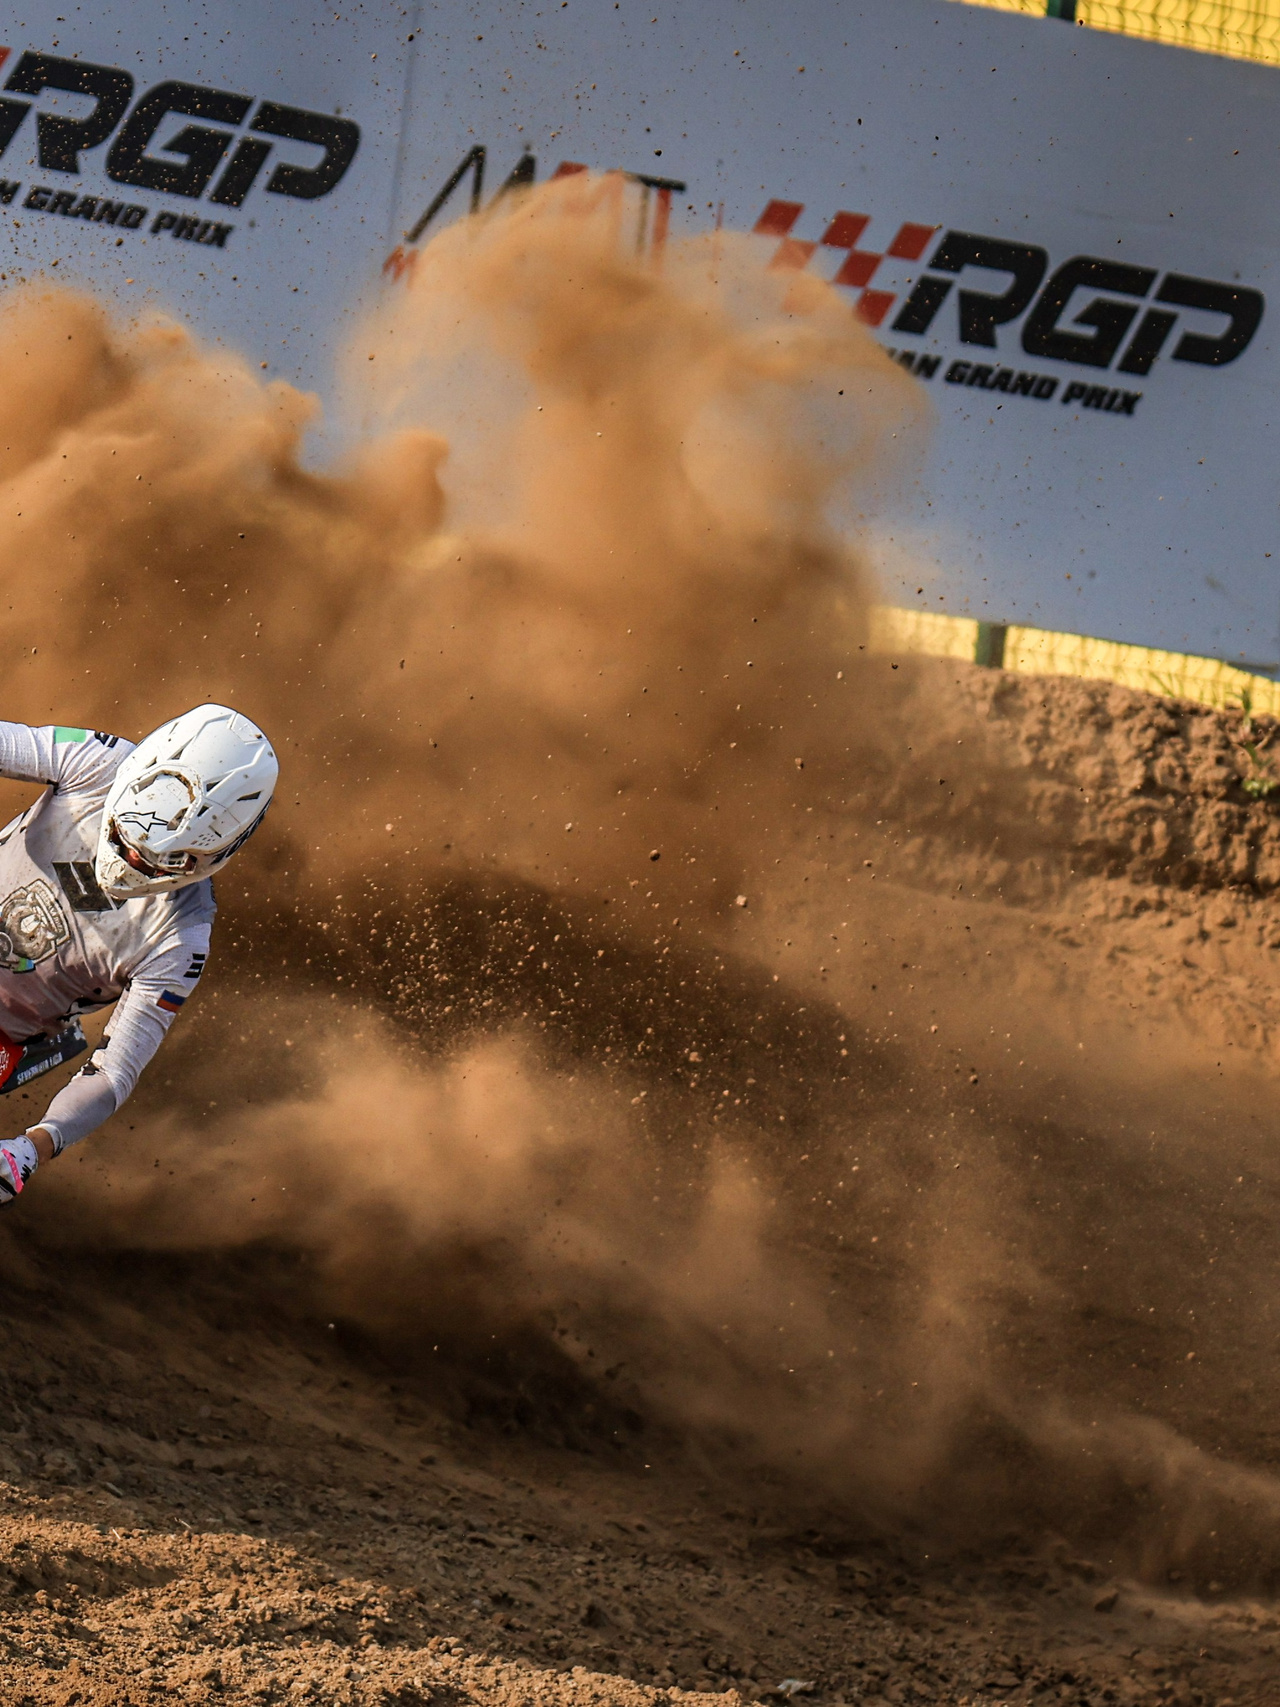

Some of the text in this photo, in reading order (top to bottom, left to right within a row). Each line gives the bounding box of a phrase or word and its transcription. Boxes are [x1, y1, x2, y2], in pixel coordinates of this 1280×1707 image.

[22, 184, 150, 231] GRAND
[150, 209, 236, 249] PRIX
[891, 229, 1266, 377] RGP
[943, 358, 1061, 401] GRAND
[1061, 379, 1144, 417] PRIX
